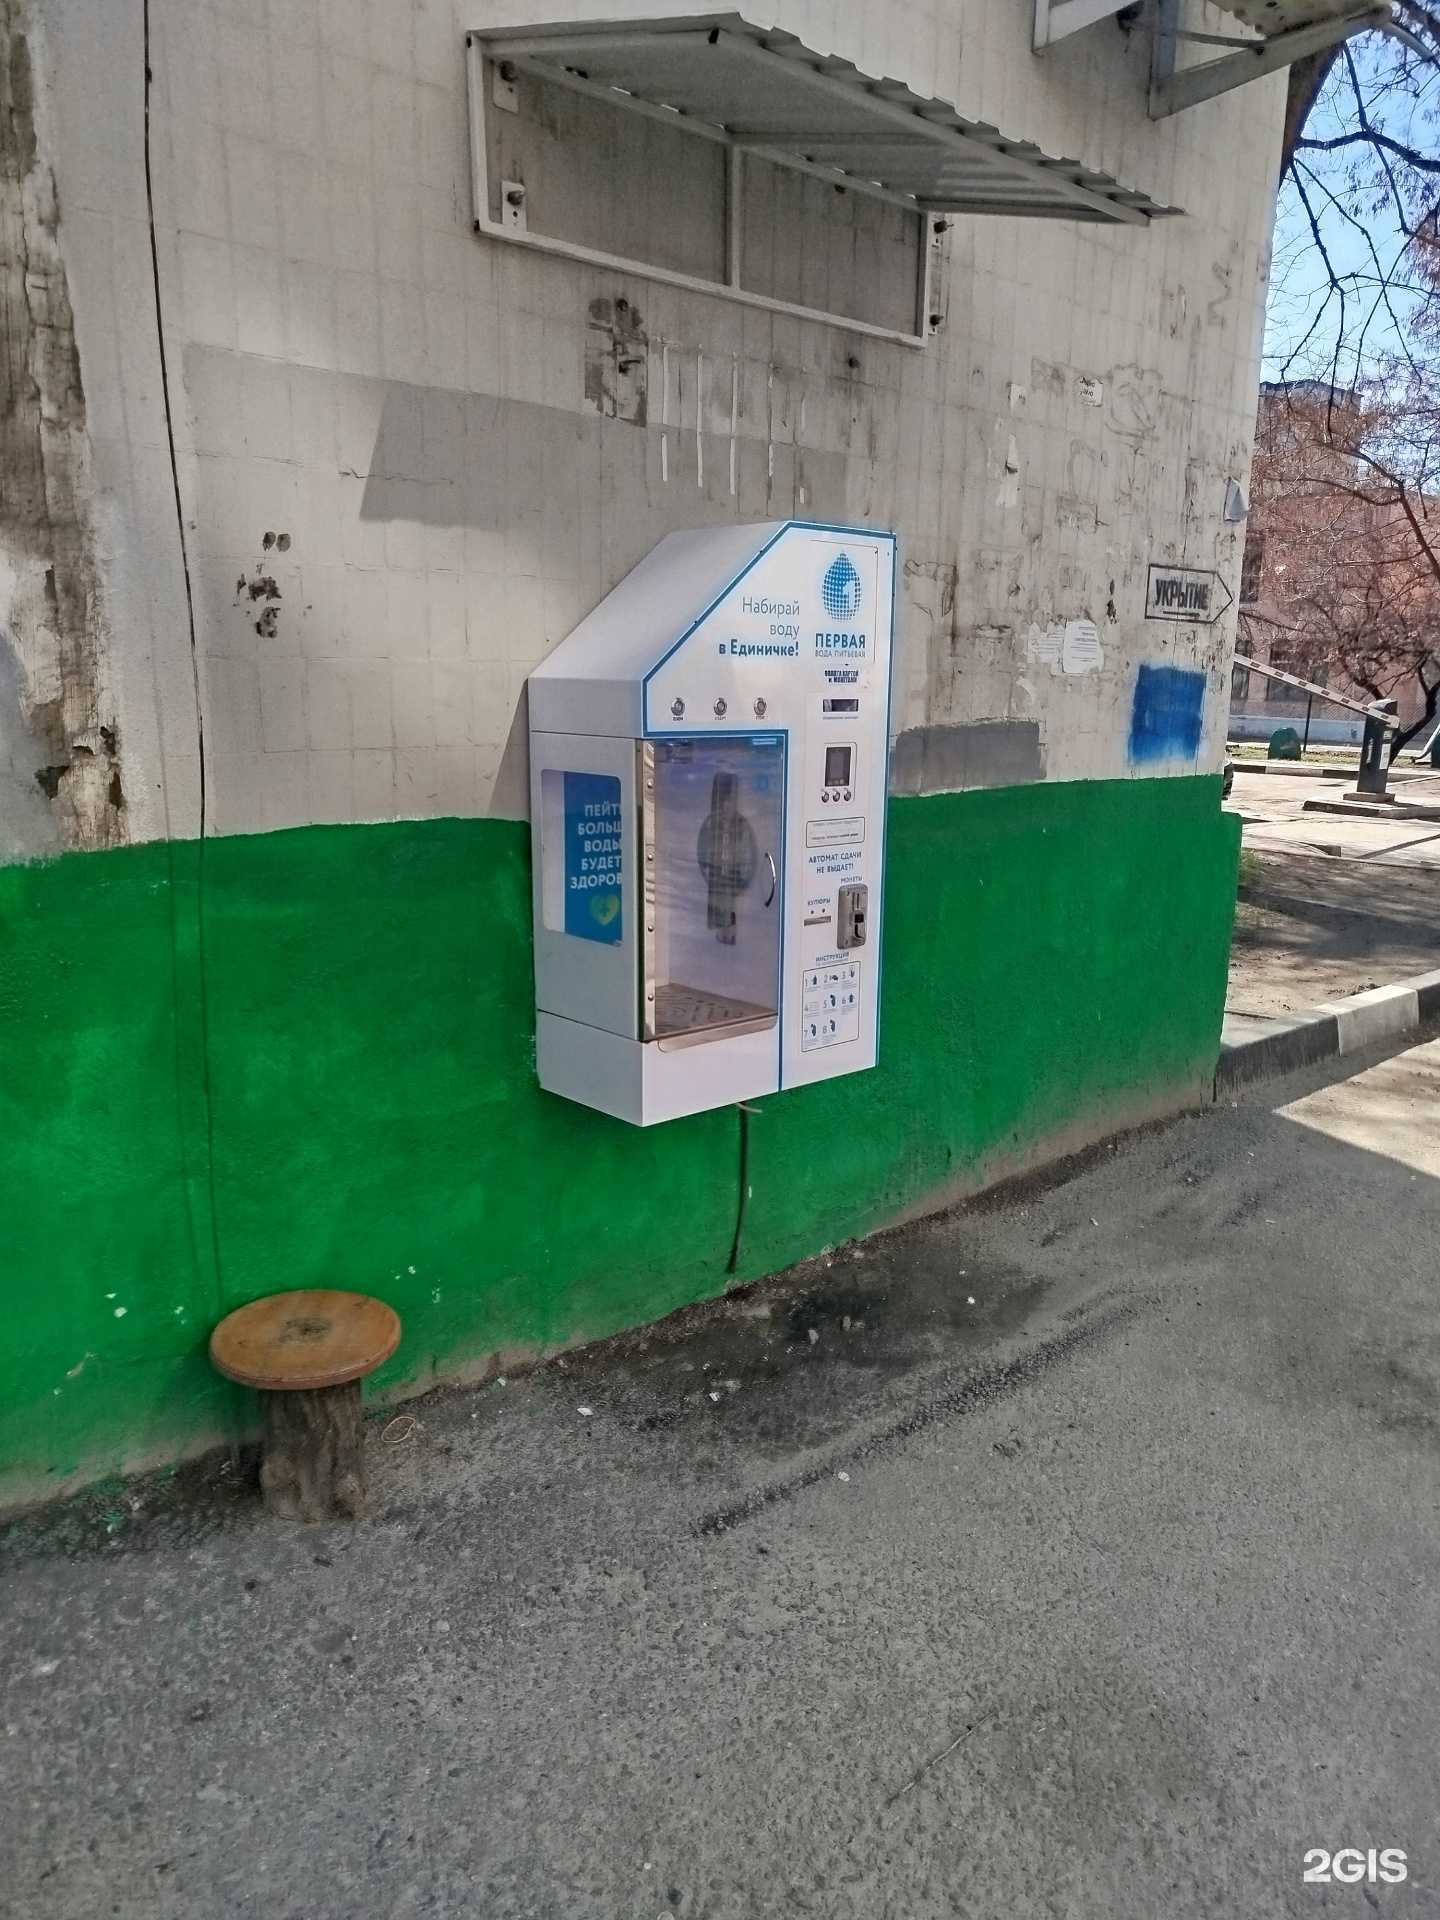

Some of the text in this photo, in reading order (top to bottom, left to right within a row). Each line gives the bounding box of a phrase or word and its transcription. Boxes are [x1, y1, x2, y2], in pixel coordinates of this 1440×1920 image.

[1155, 578, 1209, 611] УКРЫТИЕ
[742, 597, 800, 618] Набирай
[770, 624, 800, 640] воду
[719, 639, 799, 656] в Единичке!
[815, 632, 866, 649] ПЕРВАЯ
[815, 649, 866, 657] ВОДА ПИТЬЕВАЯ
[584, 801, 622, 817] ПЕЙТ
[809, 851, 862, 863] АВТОМАТ СДАЧИ
[816, 864, 854, 874] НЕ ВЫДАЕТ!
[840, 876, 862, 884] МОНЕТЫ
[807, 897, 831, 906] КУПЮРЫ
